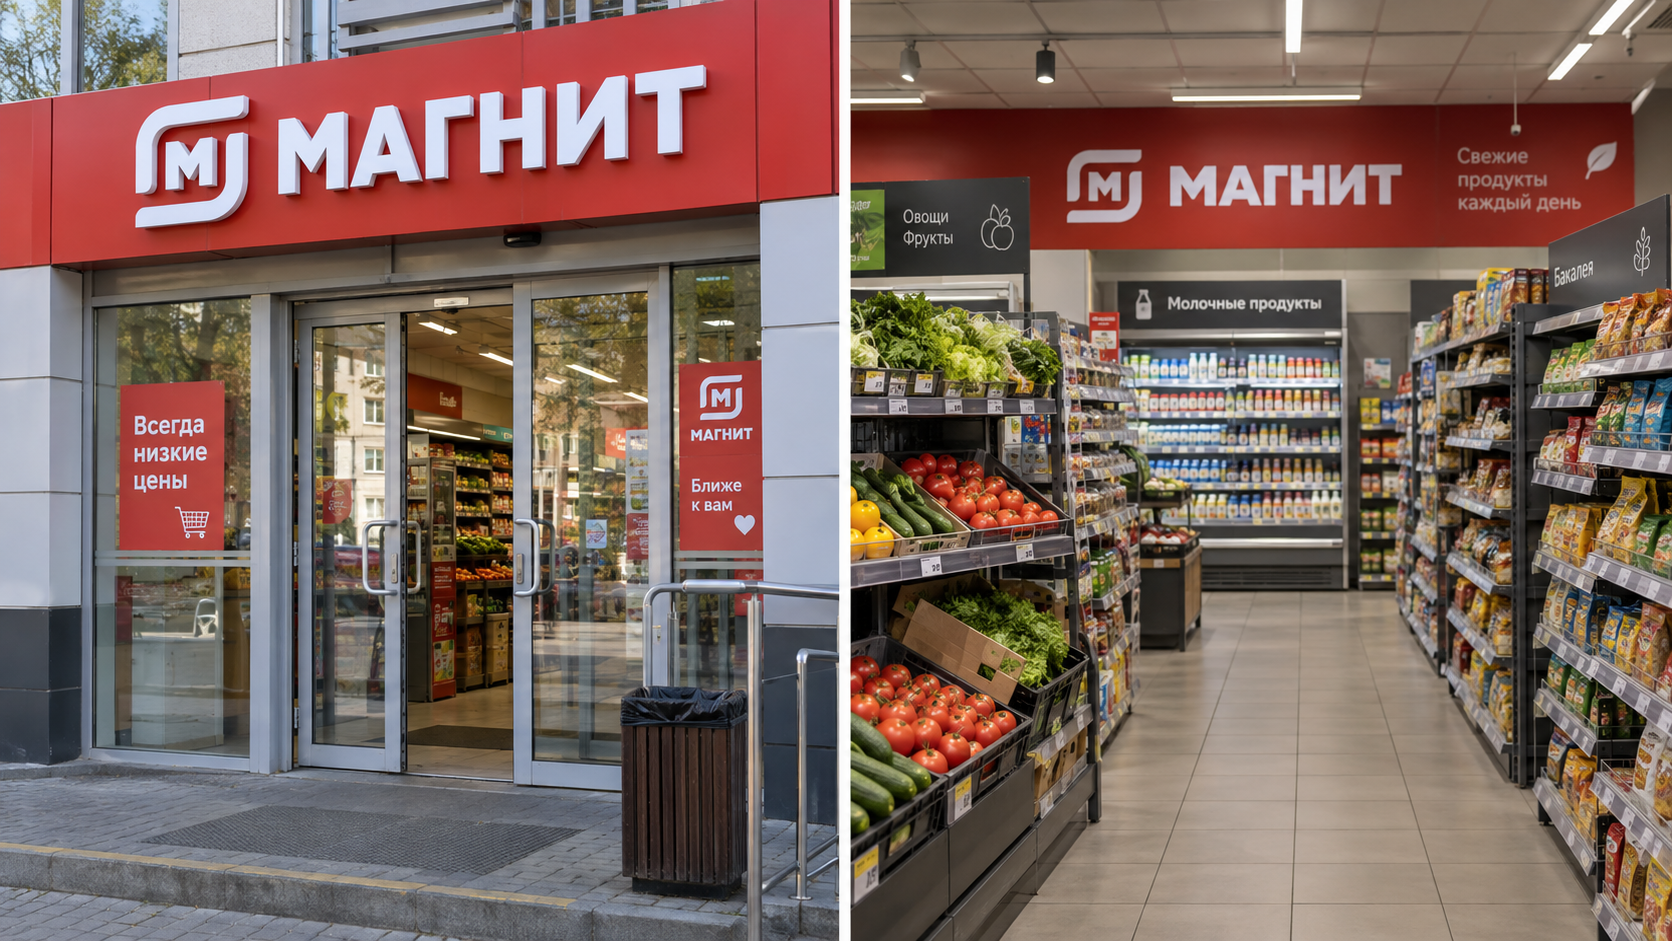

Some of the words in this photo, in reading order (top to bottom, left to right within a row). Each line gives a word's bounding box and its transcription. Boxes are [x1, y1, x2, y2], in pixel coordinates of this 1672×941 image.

[278, 64, 707, 195] МАГНИТ
[1457, 147, 1529, 165] Свежие
[1169, 164, 1402, 207] МАГНИТ
[1458, 173, 1548, 192] продукты
[1458, 194, 1532, 213] каждый
[1536, 196, 1582, 213] день
[903, 208, 949, 226] Овощи
[903, 229, 954, 249] Фрукты
[1553, 259, 1594, 288] Бакалея
[1167, 296, 1247, 311] Молочные
[1249, 298, 1322, 314] продукты
[133, 415, 205, 438] Всегда
[690, 427, 754, 442] МАГНИТ
[133, 445, 208, 463] низкие
[133, 473, 188, 494] цены
[691, 477, 743, 493] Ближе
[691, 500, 701, 512] к
[704, 500, 733, 512] вам
